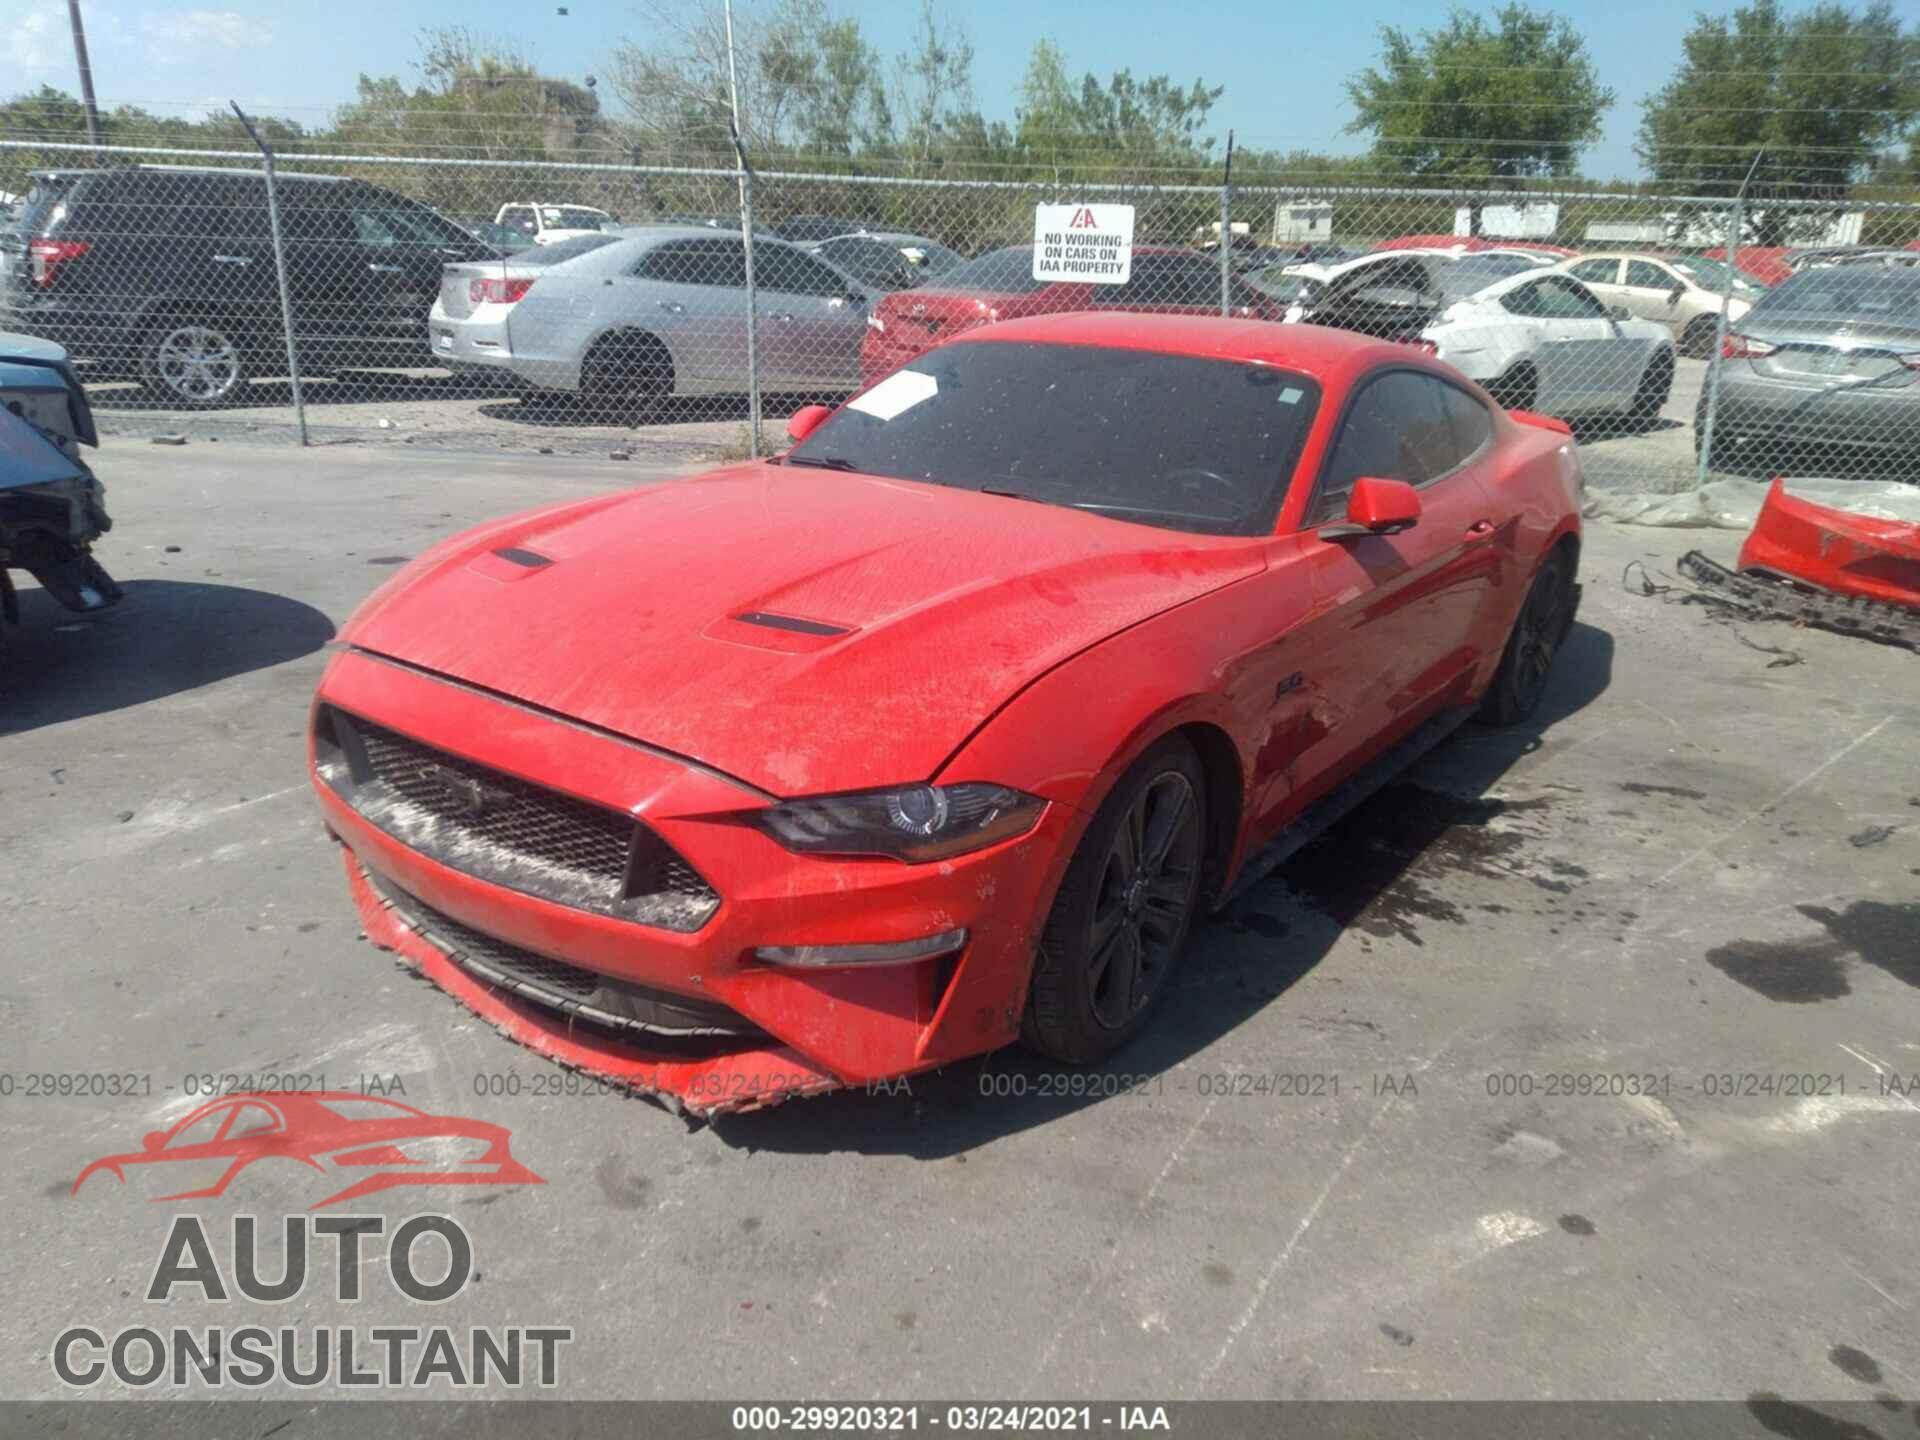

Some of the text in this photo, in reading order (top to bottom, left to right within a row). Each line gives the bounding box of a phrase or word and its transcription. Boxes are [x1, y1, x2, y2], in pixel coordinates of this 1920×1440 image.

[1044, 233, 1122, 247] NO WORKING
[1045, 246, 1117, 260] ON CARS ON
[1040, 260, 1124, 274] IAA PROPERTY
